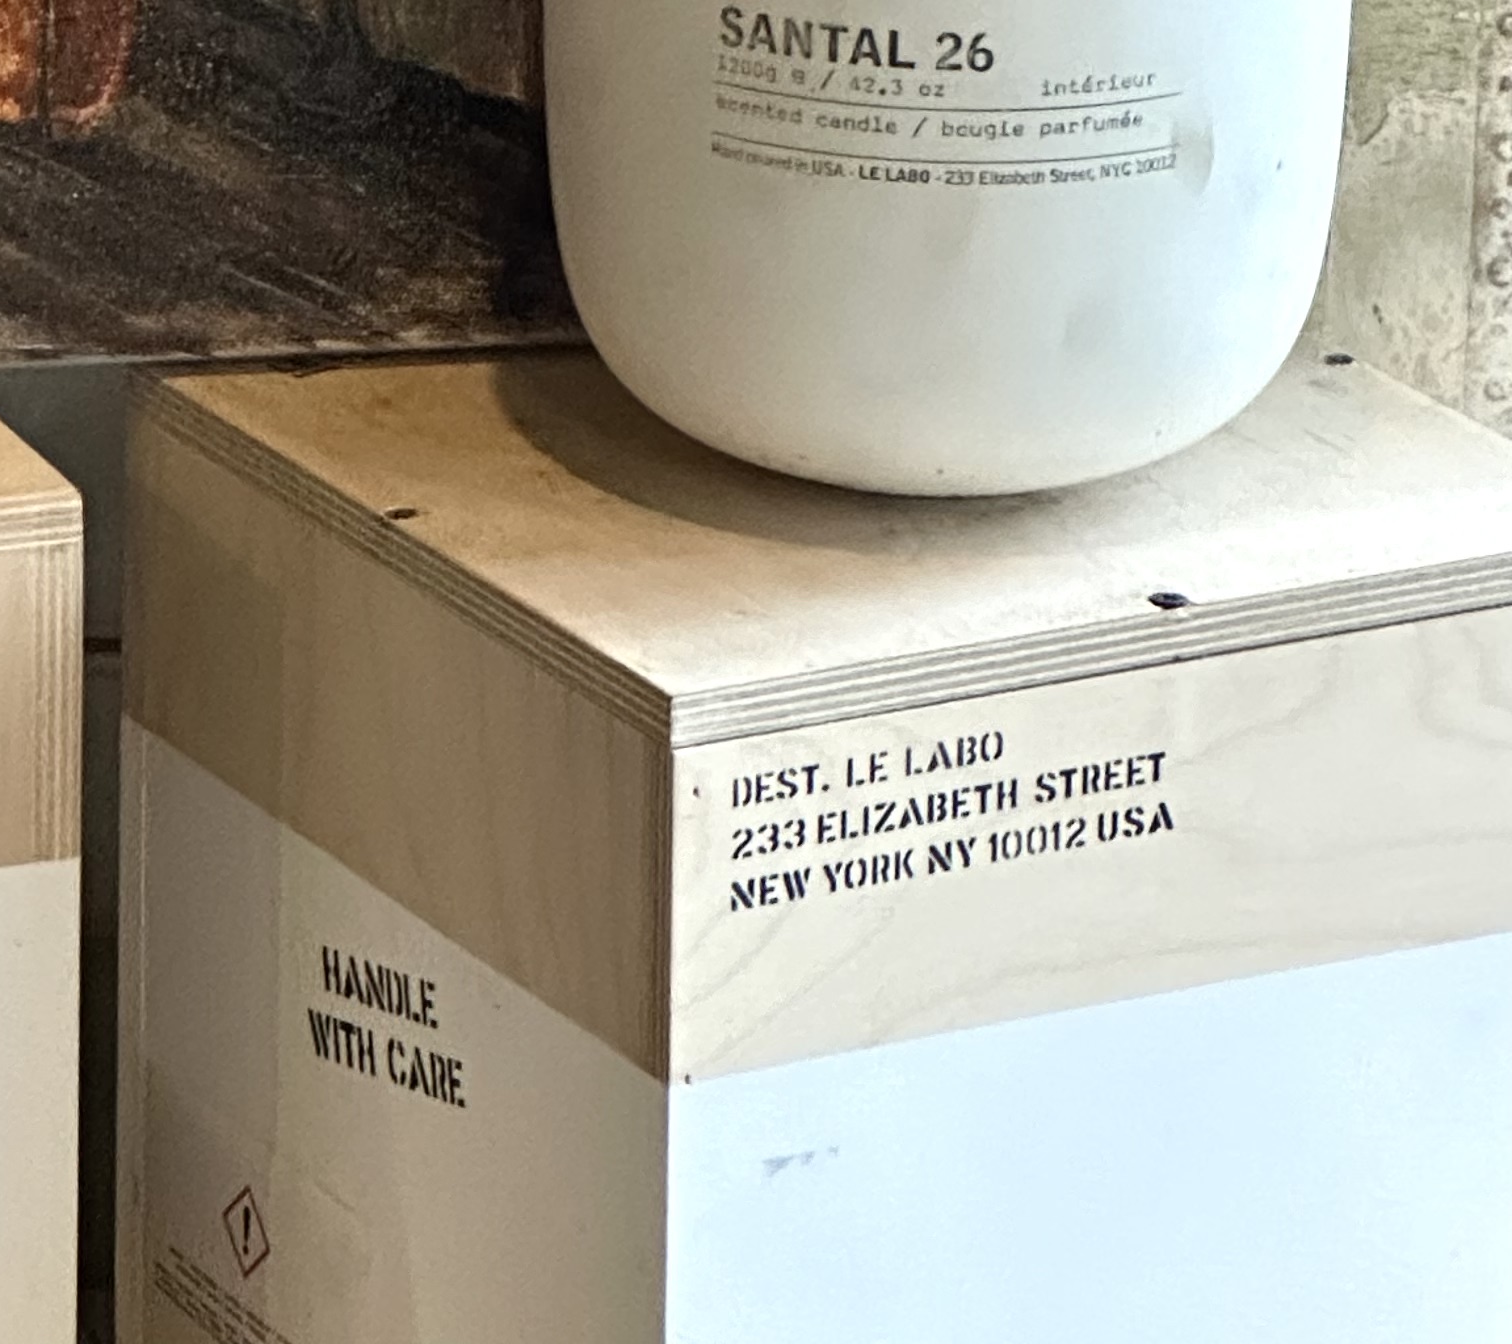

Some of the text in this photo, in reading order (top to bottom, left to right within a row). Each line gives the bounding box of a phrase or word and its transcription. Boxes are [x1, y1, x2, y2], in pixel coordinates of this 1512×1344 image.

[719, 5, 996, 73] SANTAL 26
[715, 95, 804, 124] scented
[815, 113, 897, 135] candle
[941, 119, 1025, 141] bougie
[1039, 110, 1145, 140] parfumée
[849, 75, 904, 97] 42.3
[918, 85, 947, 98] oz
[1040, 71, 1158, 97] intérieur
[811, 161, 846, 177] USA
[858, 164, 882, 181] LE
[885, 165, 931, 184] LABO
[978, 168, 1046, 187] Elizabeth
[1100, 162, 1132, 178] NYC
[730, 750, 1167, 861] 233 ELIZABETH STREET
[731, 730, 1005, 809] DEST. LE LABO
[729, 800, 1176, 913] NEW YORK NY 10012 USA
[321, 944, 440, 1030] HANDLE
[307, 1007, 467, 1109] WITH CARE
